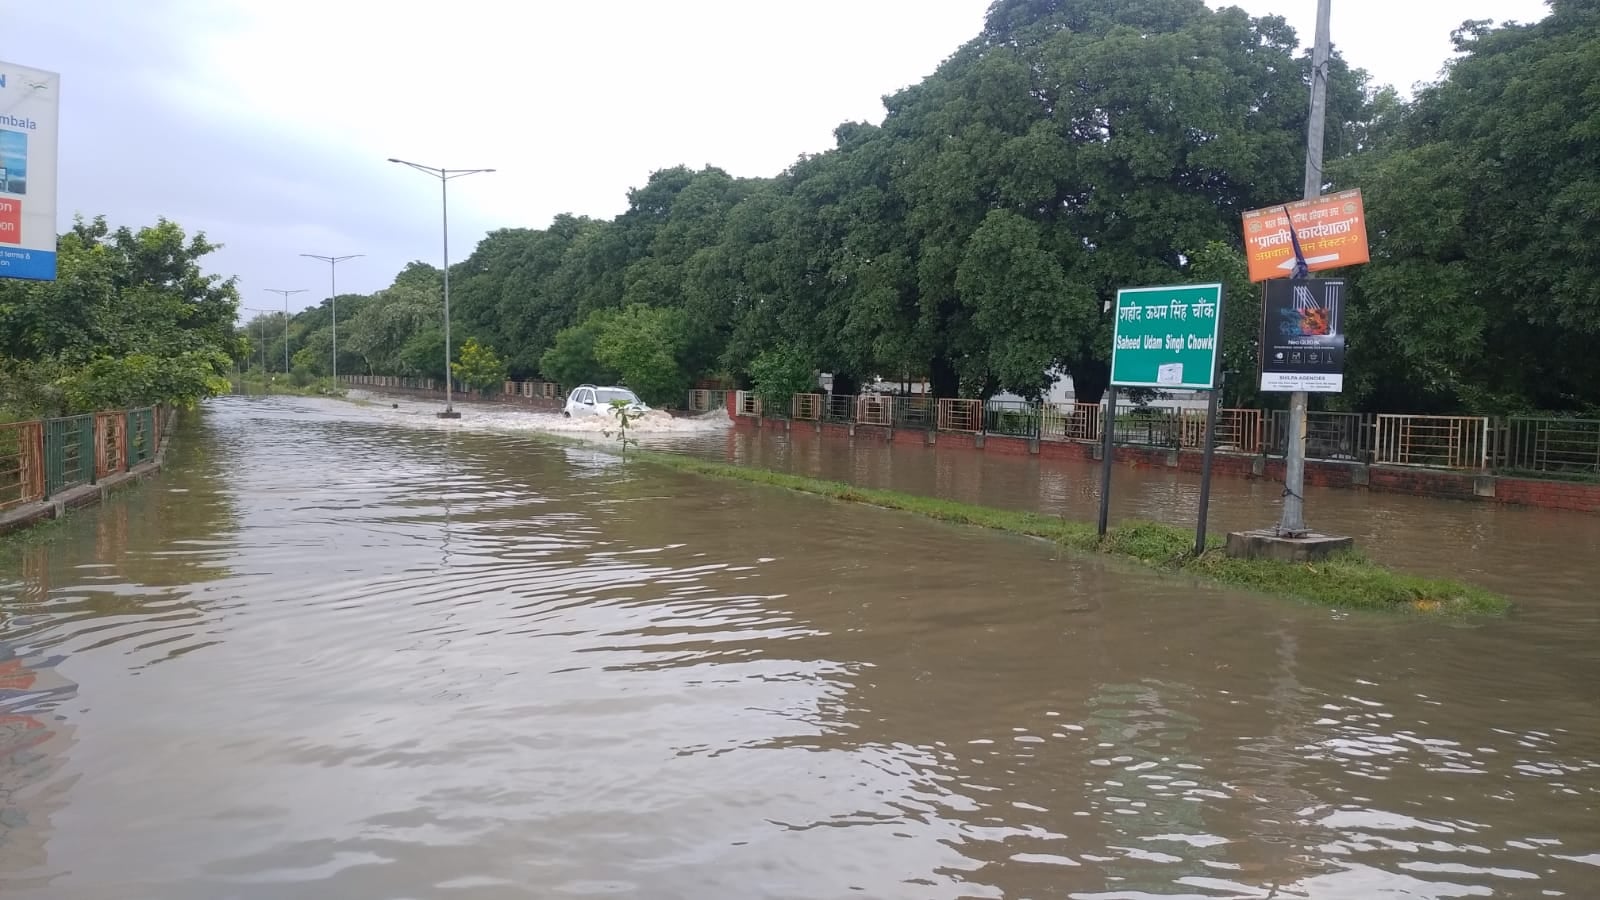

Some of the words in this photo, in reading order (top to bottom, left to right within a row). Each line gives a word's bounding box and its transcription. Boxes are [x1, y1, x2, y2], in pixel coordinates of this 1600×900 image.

[1120, 301, 1142, 322] शहीद
[1145, 305, 1168, 319] ऊधम
[1170, 299, 1188, 321] सिंह
[1117, 335, 1141, 350] Saheed
[1144, 334, 1163, 350] Udam
[1165, 334, 1184, 354] Singh
[1187, 333, 1214, 350] Chowk
